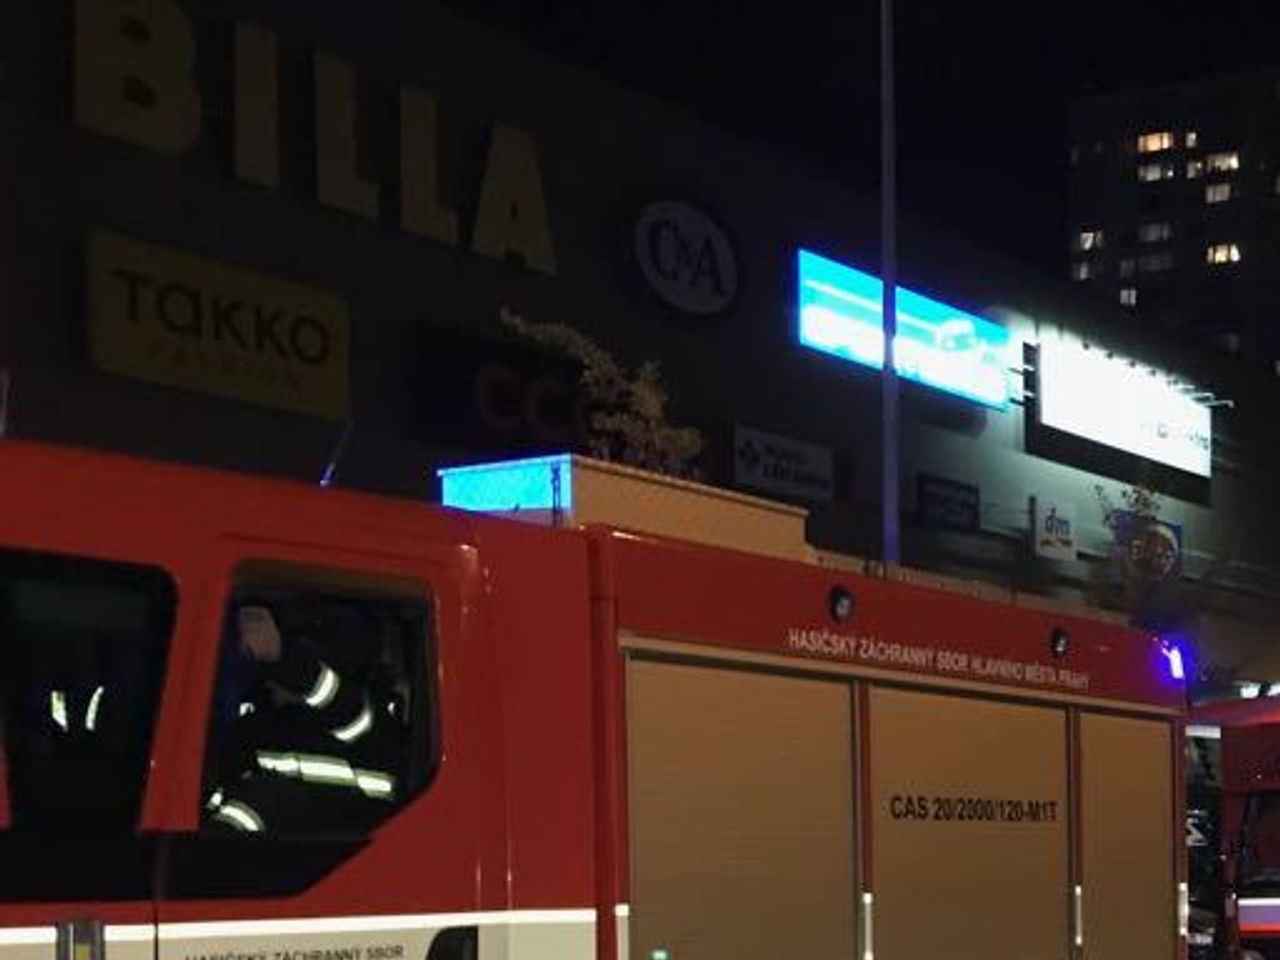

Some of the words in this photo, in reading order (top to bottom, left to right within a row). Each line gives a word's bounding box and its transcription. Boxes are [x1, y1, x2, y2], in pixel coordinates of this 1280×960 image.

[70, 0, 560, 278] BILLA
[889, 795, 929, 821] CAS
[366, 944, 405, 960] SBOR
